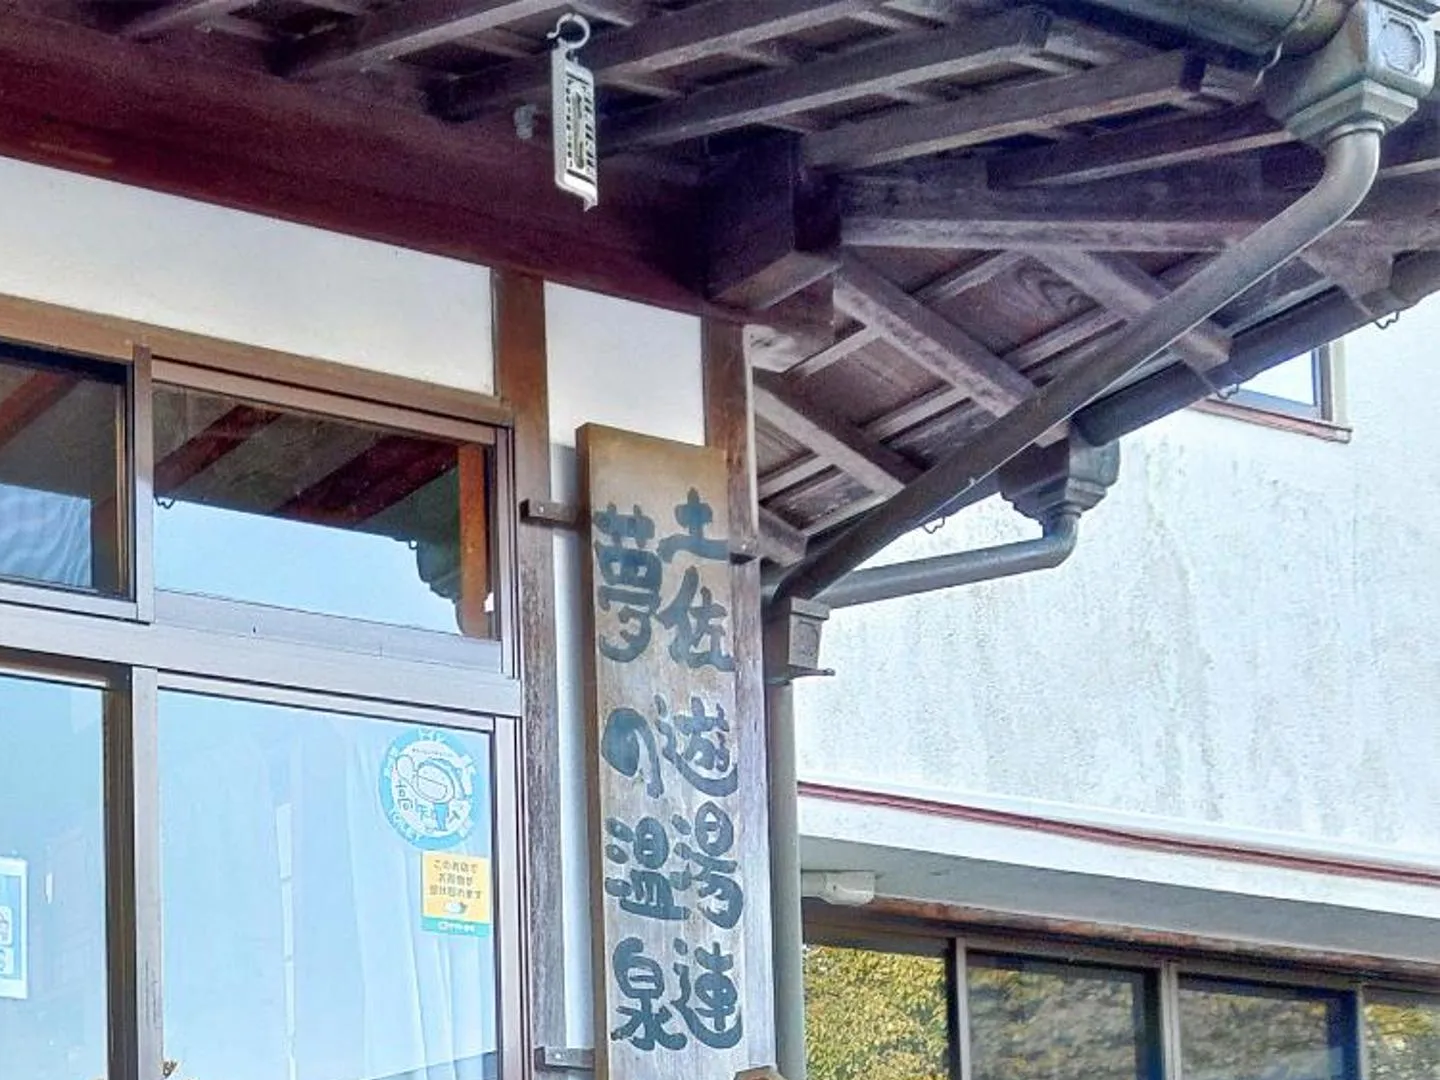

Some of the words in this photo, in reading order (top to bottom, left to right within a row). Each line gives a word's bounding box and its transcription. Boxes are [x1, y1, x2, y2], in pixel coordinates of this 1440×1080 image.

[593, 502, 691, 1051] 夢の温泉
[655, 487, 744, 1049] 土佐遊湯連
